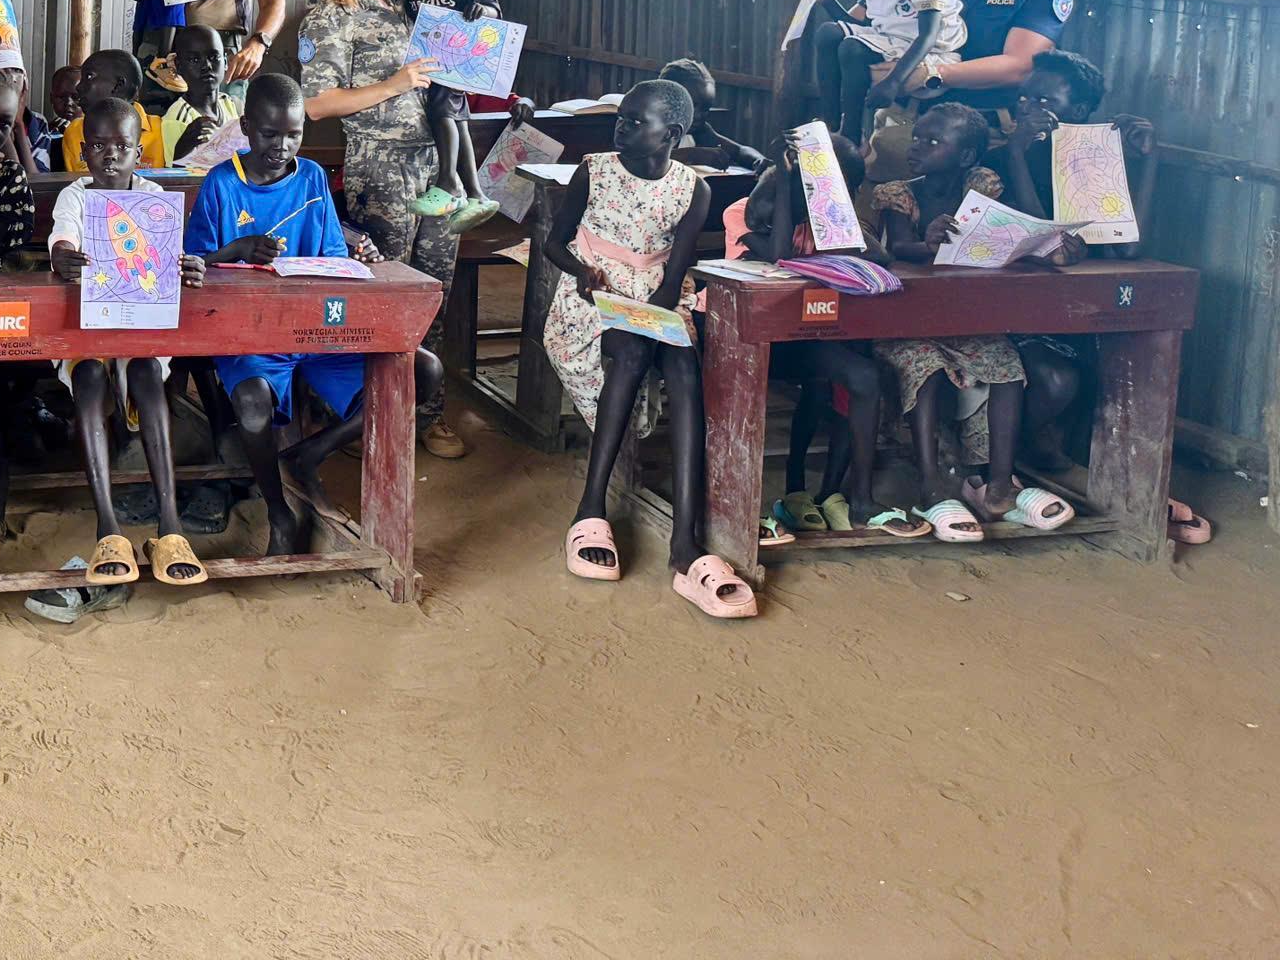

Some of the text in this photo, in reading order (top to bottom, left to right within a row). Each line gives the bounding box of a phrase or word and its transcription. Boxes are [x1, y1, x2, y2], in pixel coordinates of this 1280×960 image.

[806, 301, 836, 315] NRC
[293, 327, 376, 336] NORWEGIAN MINISTRY
[295, 336, 305, 344] OF
[8, 348, 43, 356] COUNCIL
